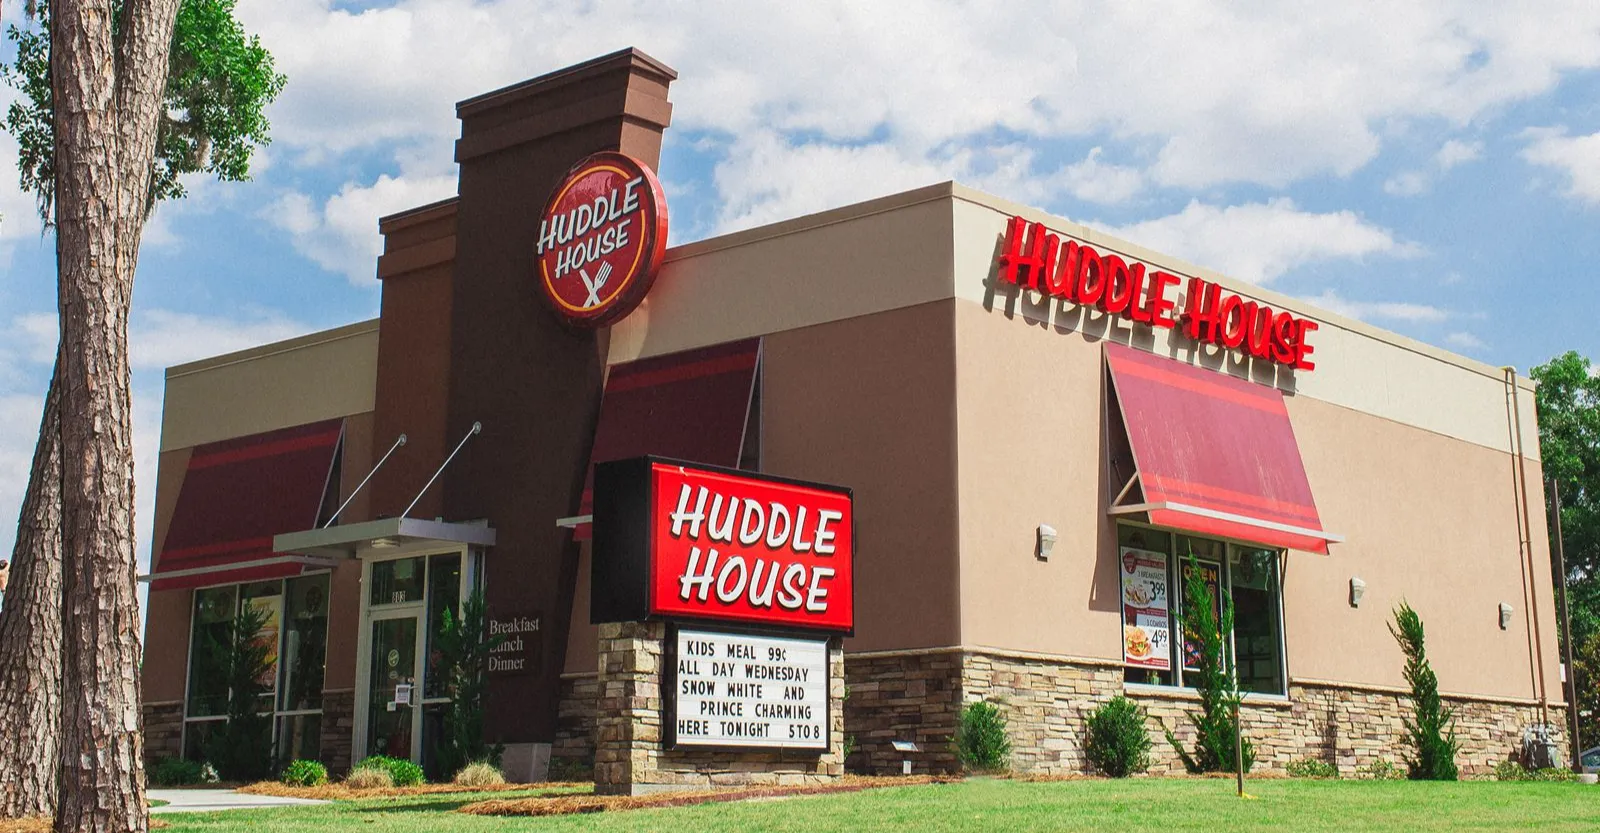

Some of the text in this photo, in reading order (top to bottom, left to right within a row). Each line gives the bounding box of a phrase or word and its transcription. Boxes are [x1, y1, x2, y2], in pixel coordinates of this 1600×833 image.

[537, 176, 643, 255] HUDDLE
[555, 219, 631, 279] HOUSE
[998, 215, 1319, 372] HUDDLE HOUSE
[669, 483, 843, 554] HUDDLE
[678, 546, 836, 612] HOUSE
[1184, 565, 1217, 583] OEN
[489, 616, 539, 634] Breakfast
[489, 635, 524, 653] unch
[687, 640, 715, 657] KIDS
[727, 644, 757, 660] MEAL
[488, 656, 525, 671] Dinner
[678, 660, 809, 682] ALL DAY WEDNESDAY
[682, 680, 805, 700] SNOW WHITE AND
[700, 701, 812, 720] PRINCE CHARMING
[678, 720, 709, 735] HERE
[720, 721, 770, 738] TONIGHT
